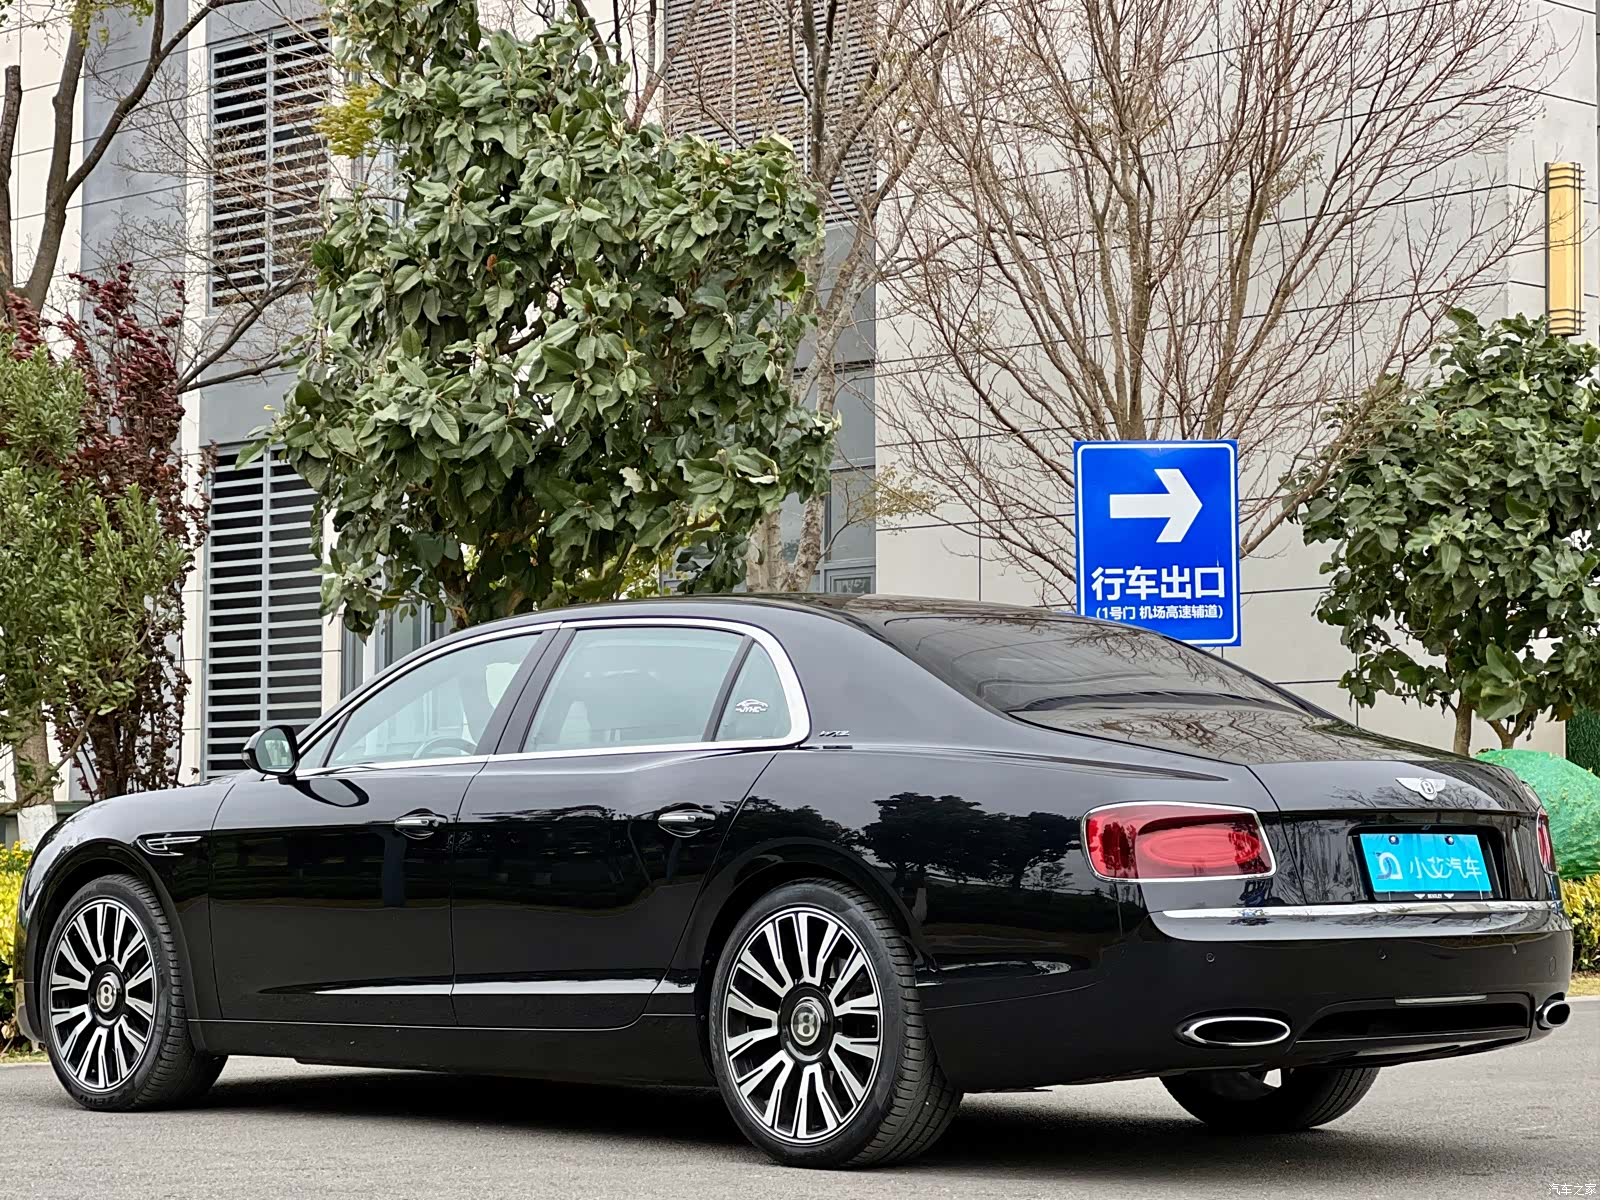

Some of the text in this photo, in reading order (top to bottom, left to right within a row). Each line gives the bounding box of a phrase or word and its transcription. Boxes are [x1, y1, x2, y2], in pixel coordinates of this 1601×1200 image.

[1091, 565, 1225, 601] 行车出口
[1096, 604, 1223, 620] (1号门 机场高速辅道)
